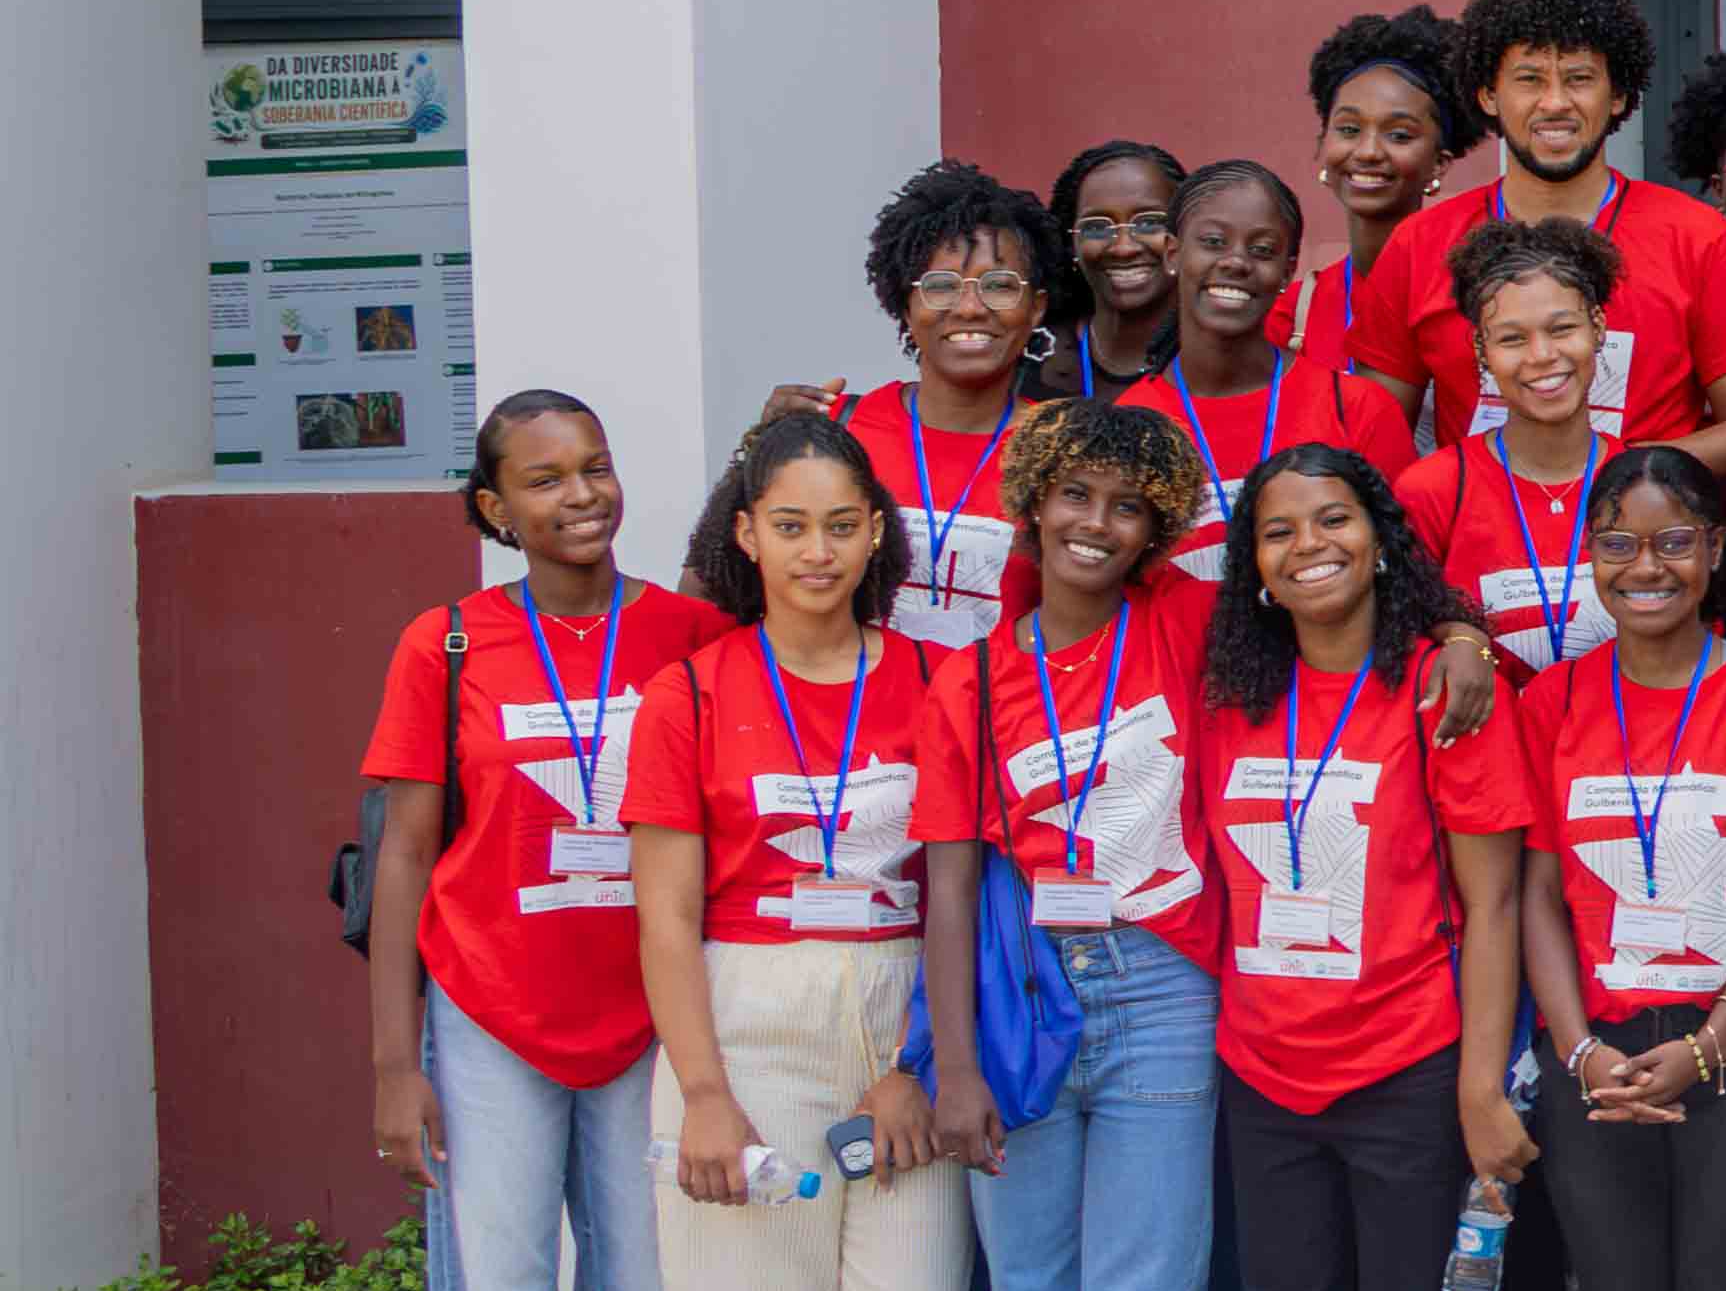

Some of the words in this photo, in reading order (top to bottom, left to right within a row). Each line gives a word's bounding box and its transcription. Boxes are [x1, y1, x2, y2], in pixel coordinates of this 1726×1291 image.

[267, 57, 288, 76] DA
[294, 51, 399, 75] DIVERSIDADE
[268, 77, 386, 102] MICROBIANA
[263, 104, 337, 125] SOBERANIA
[339, 99, 409, 120] CIENTÍFICA
